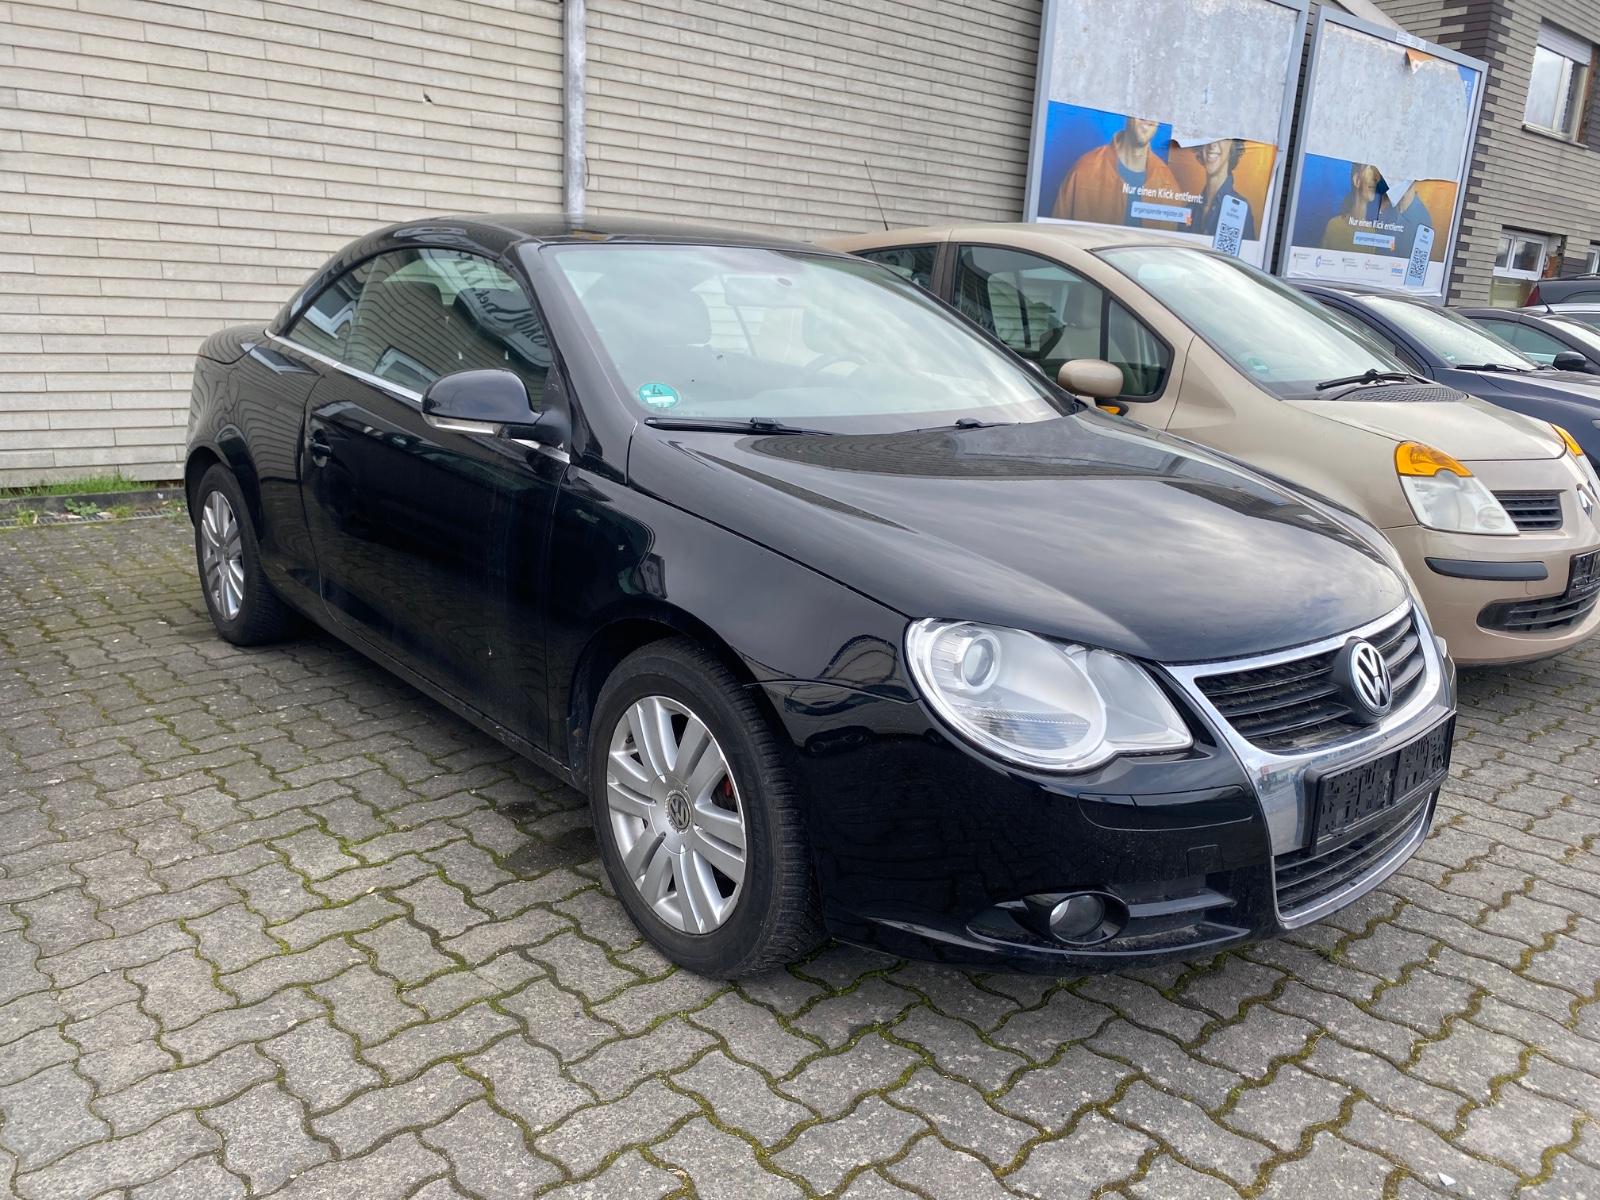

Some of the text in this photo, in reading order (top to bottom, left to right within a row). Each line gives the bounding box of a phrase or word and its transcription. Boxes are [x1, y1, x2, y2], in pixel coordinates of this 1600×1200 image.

[1122, 183, 1137, 194] Nur
[1136, 185, 1157, 198] einen
[1351, 642, 1393, 714] VW
